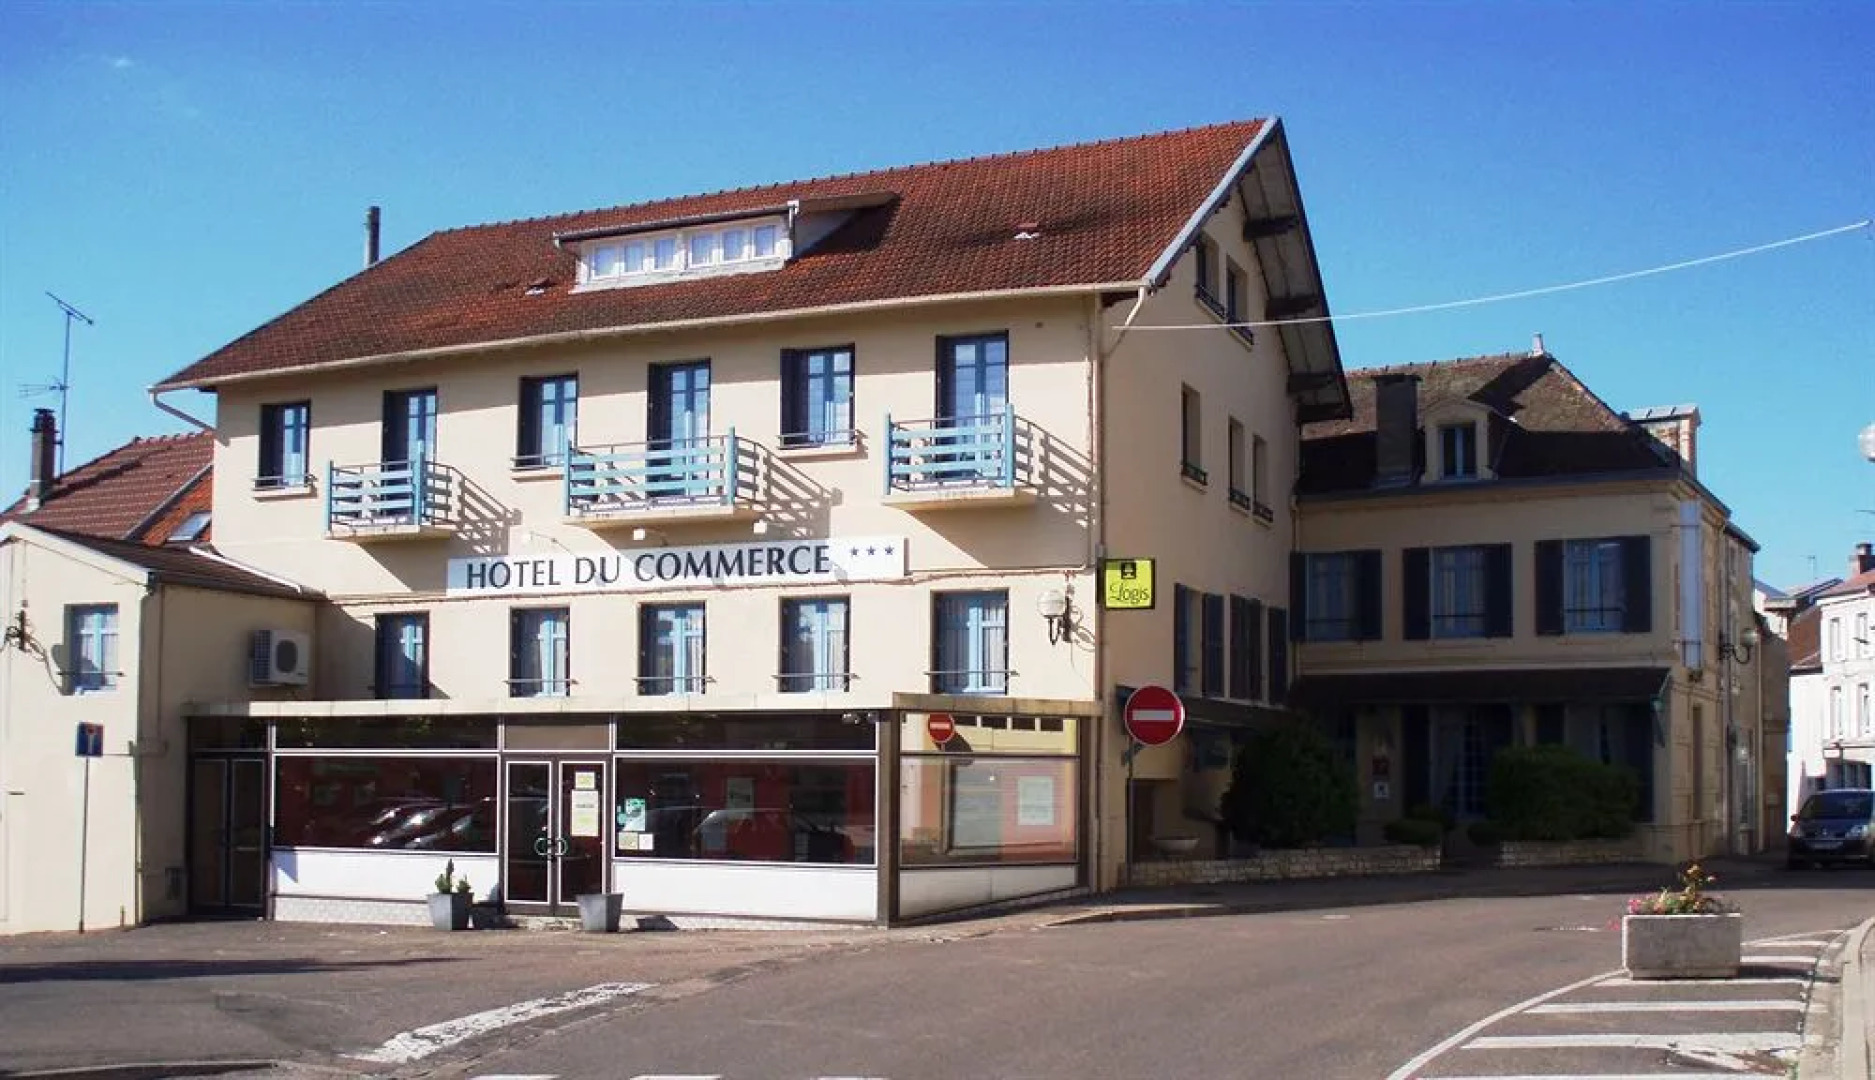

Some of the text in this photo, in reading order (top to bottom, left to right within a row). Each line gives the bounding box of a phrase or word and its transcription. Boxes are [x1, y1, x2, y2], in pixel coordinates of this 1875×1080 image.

[467, 545, 830, 590] HOTEL DU COMMERCE
[1109, 582, 1150, 604] Logis
